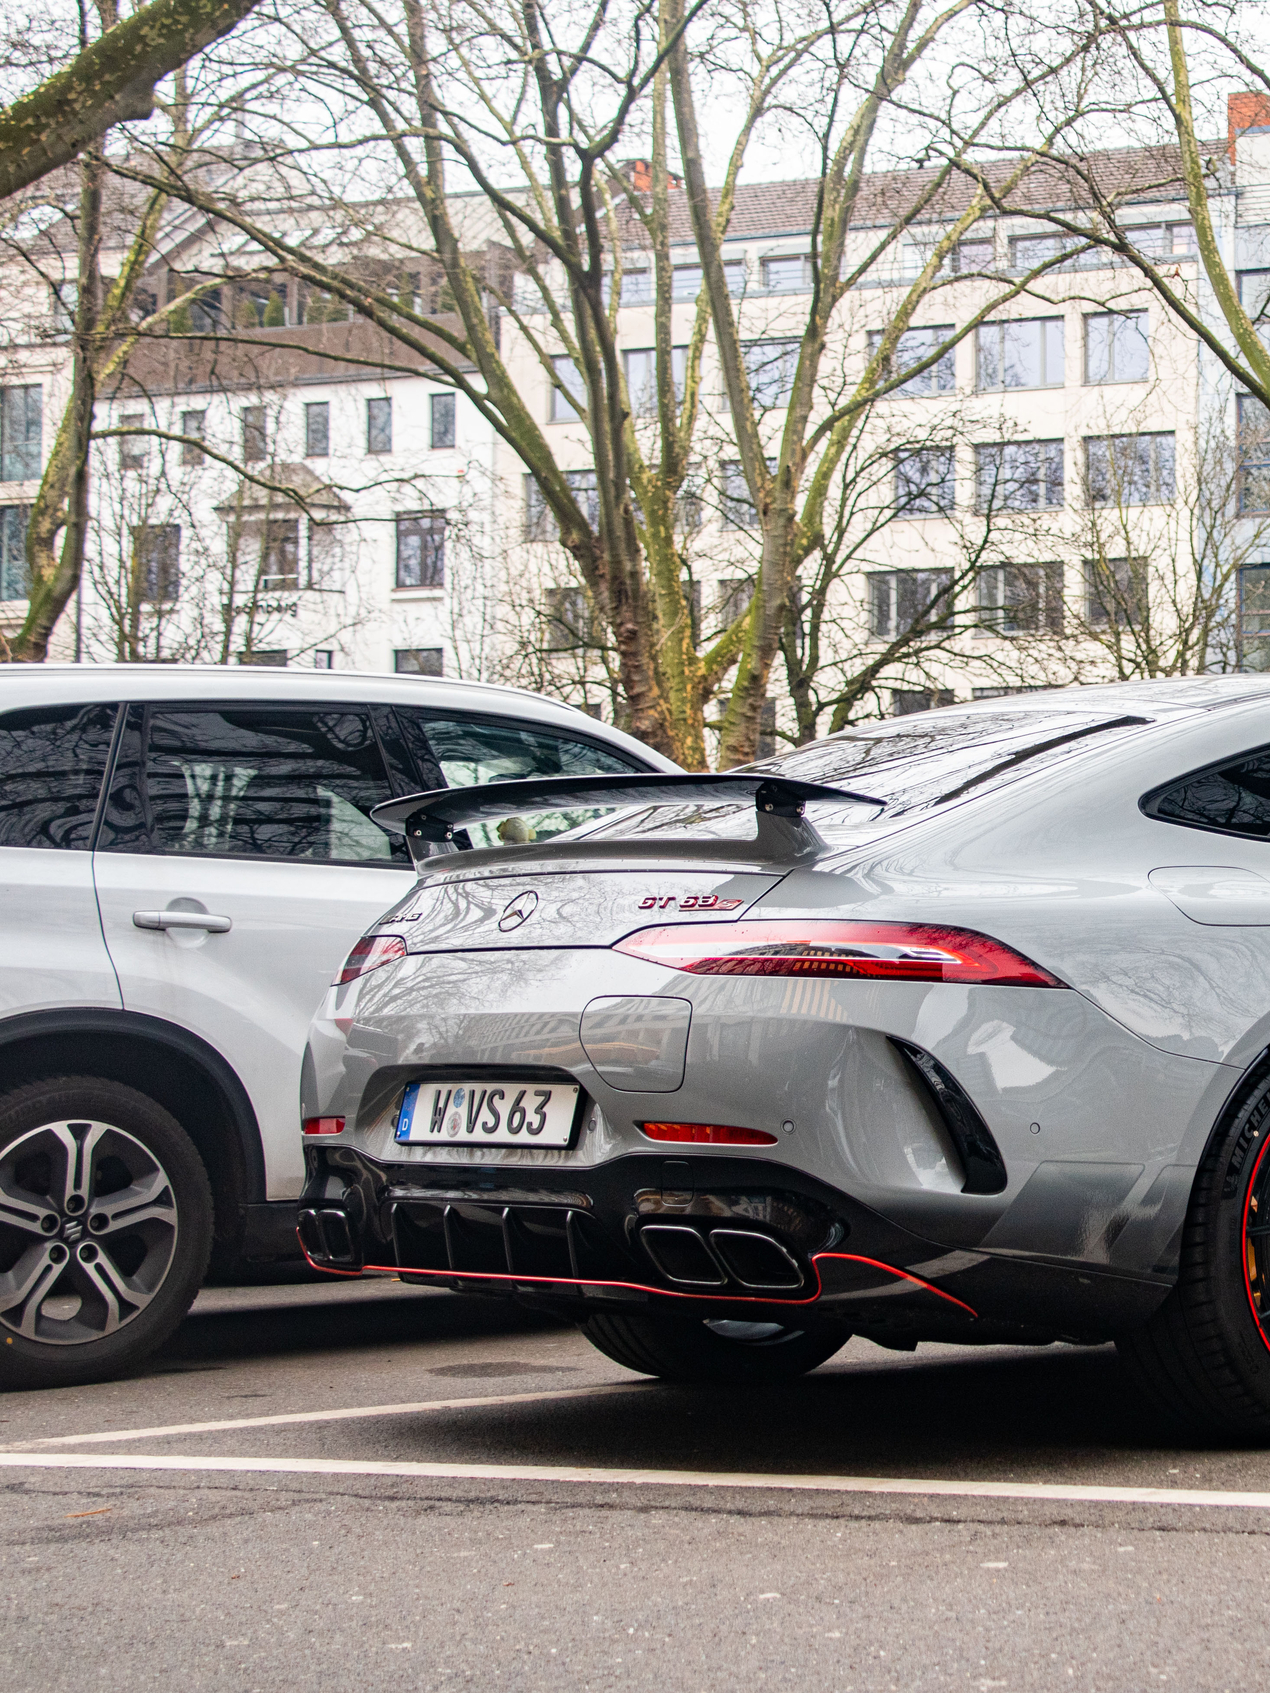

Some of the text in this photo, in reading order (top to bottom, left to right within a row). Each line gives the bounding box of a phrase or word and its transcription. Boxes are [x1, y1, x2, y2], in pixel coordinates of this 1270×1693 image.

[638, 896, 676, 909] GT
[429, 1089, 452, 1134] W
[401, 1118, 409, 1131] D
